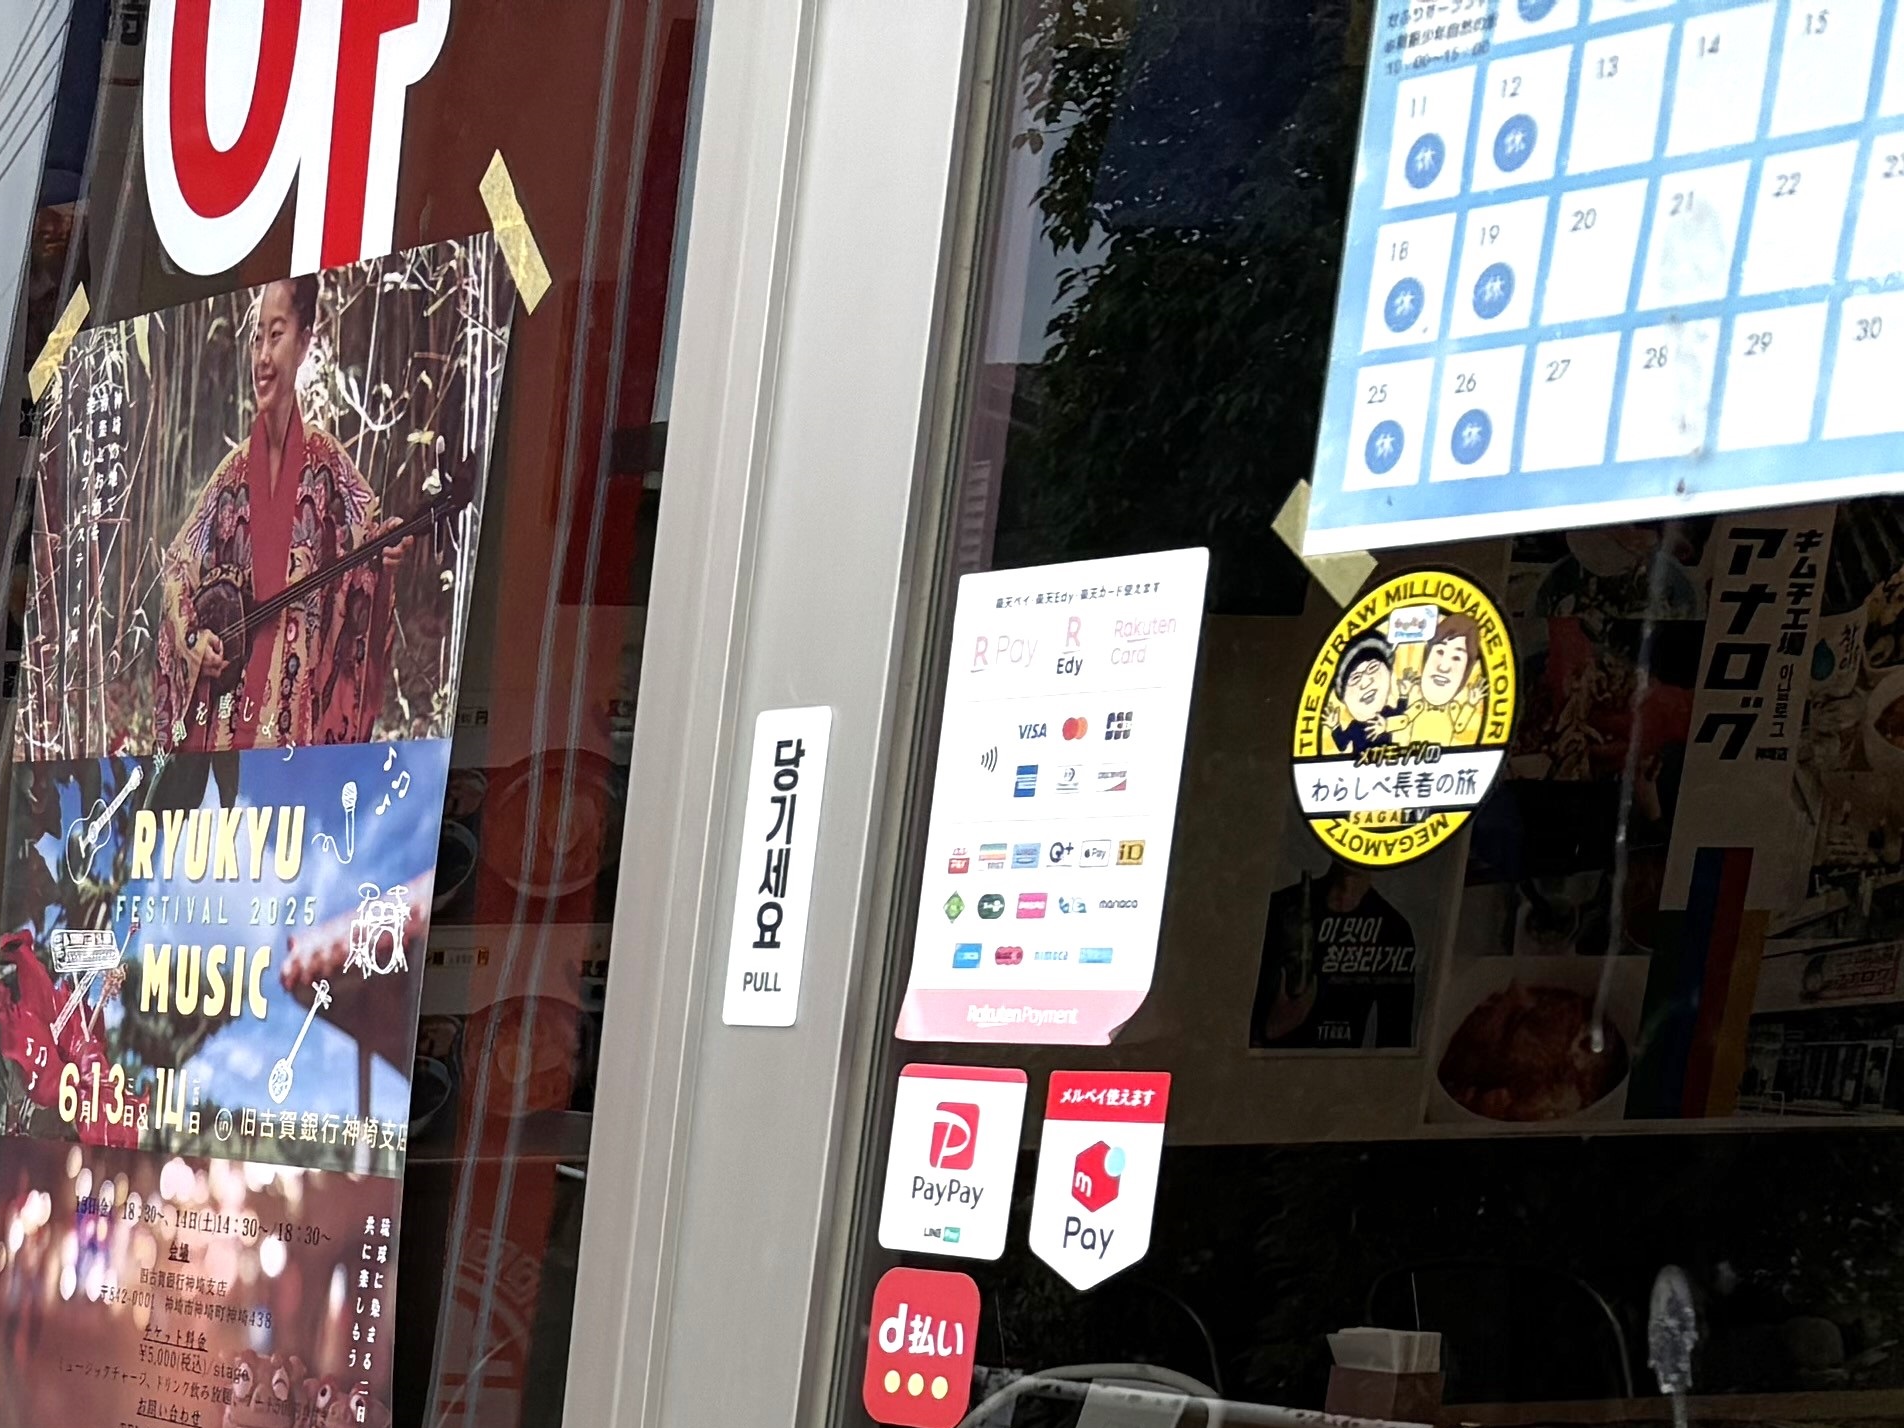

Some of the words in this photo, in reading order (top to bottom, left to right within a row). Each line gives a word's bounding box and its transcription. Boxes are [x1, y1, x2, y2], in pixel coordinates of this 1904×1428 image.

[1410, 96, 1427, 118] 11
[1501, 76, 1523, 98] 12
[1595, 55, 1620, 79] 13
[1697, 34, 1721, 58] 14
[1803, 9, 1830, 36] 15
[1390, 241, 1410, 262] 18
[1479, 224, 1501, 246] 19
[1569, 208, 1598, 233] 20
[1668, 191, 1695, 217] 21
[1772, 172, 1802, 198] 22
[1367, 384, 1388, 404] 25
[1454, 373, 1478, 394] 26
[1545, 359, 1571, 382] 27
[1642, 346, 1669, 370] 28
[1743, 331, 1774, 357] 29
[1854, 316, 1883, 341] 30
[1114, 618, 1177, 640] Rakuten
[1694, 527, 1789, 761] アナログ
[1056, 657, 1083, 676] Edy
[1111, 644, 1147, 665] Card
[1299, 695, 1321, 753] THE
[1314, 598, 1379, 691] STRAW
[1385, 579, 1501, 655] MILLIONAIRE
[1487, 654, 1509, 740] TOUR
[1018, 723, 1048, 740] VISA
[131, 805, 307, 882] RYUKYU
[752, 738, 806, 950] 당기세요
[115, 895, 229, 926] FESTIVAL
[250, 895, 318, 926] 2025
[139, 943, 271, 1019] MUSIC
[743, 971, 782, 993] PULL
[1058, 1087, 1156, 1109] メルペイ使えます
[912, 1175, 985, 1210] PayPay
[1063, 1216, 1115, 1260] Pay
[879, 1303, 966, 1357] d払い
